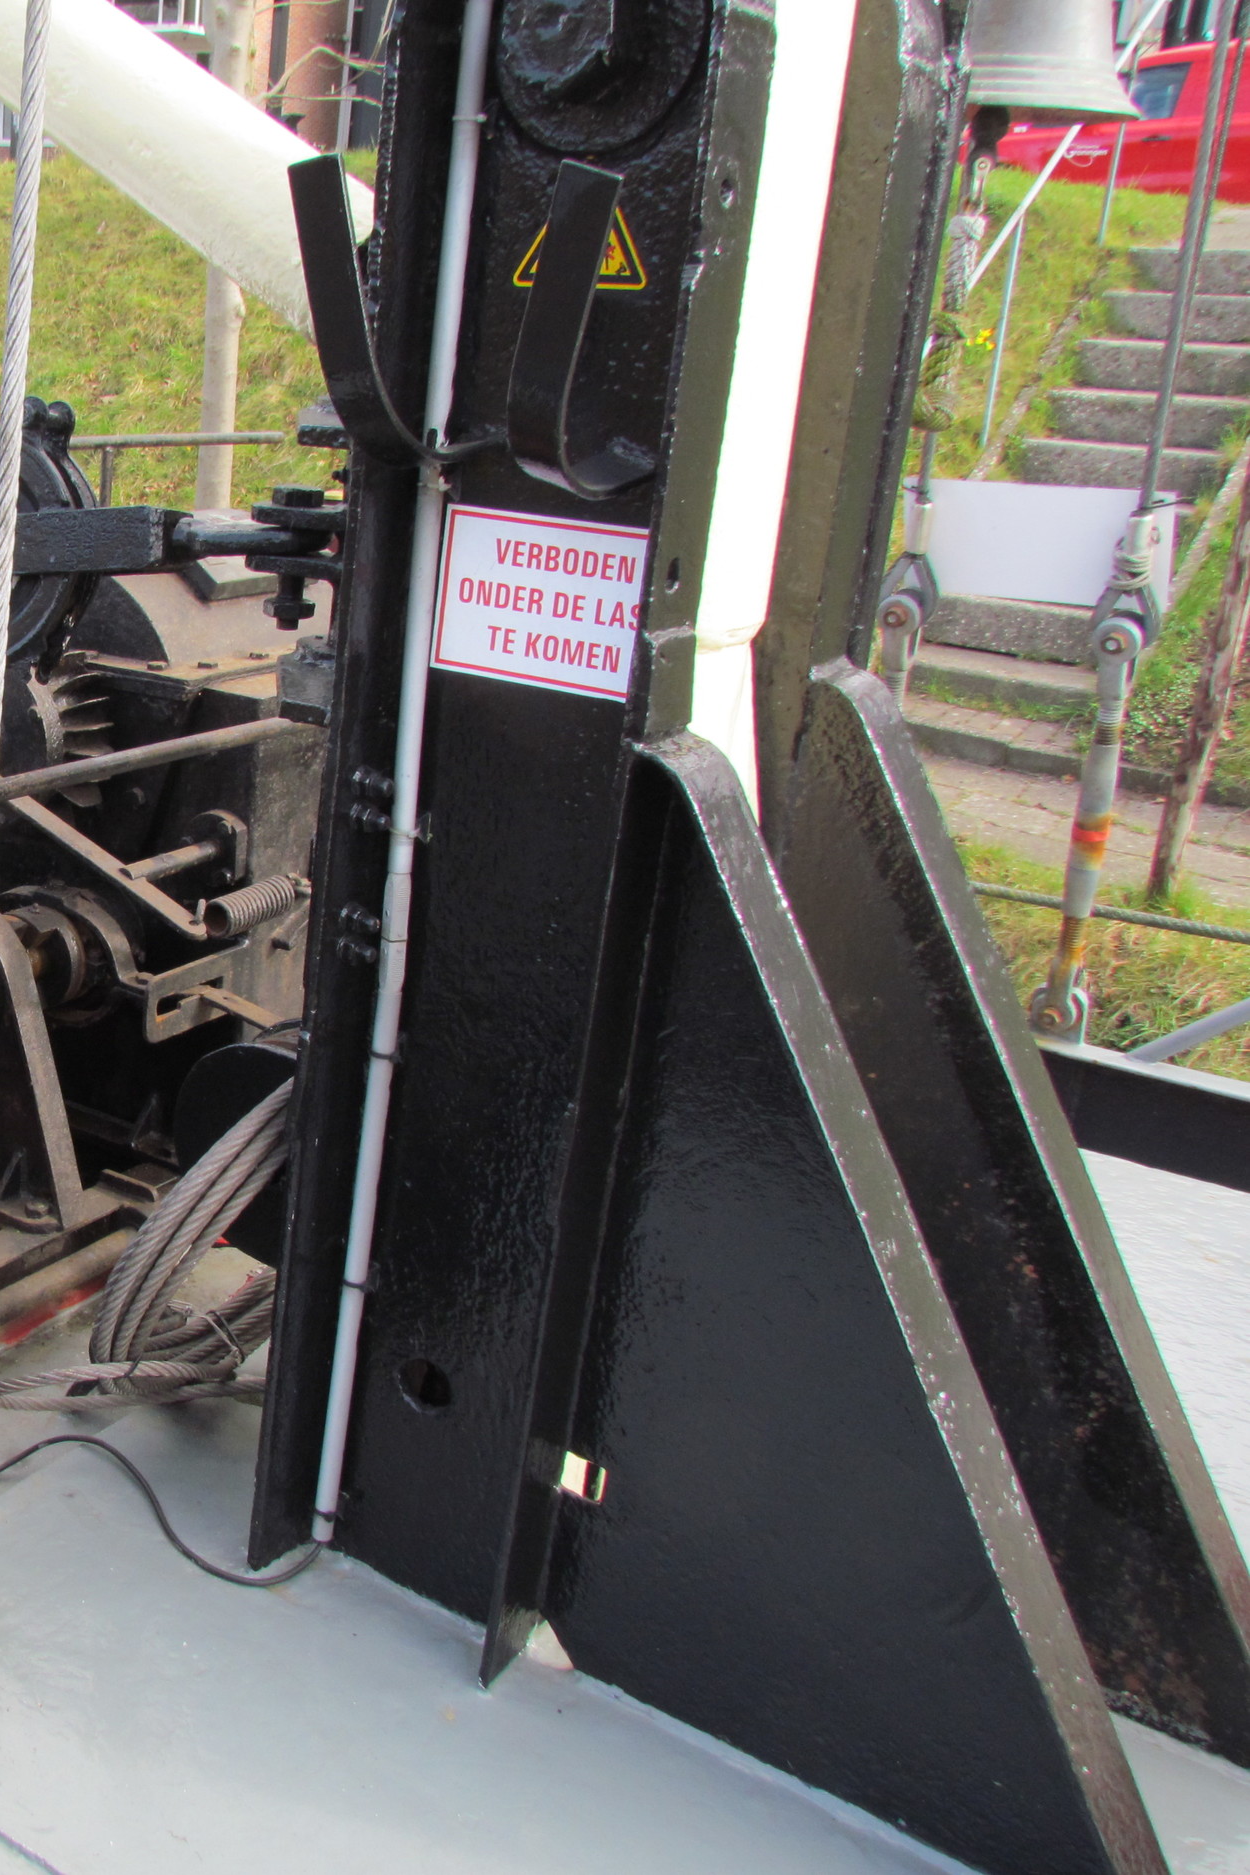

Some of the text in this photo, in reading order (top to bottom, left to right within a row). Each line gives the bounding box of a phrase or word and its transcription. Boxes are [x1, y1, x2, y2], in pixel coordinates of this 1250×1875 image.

[496, 538, 636, 583] VERBODEN
[458, 577, 544, 615] ONDER
[551, 591, 586, 622] DE
[488, 625, 621, 673] TE KOMEN
